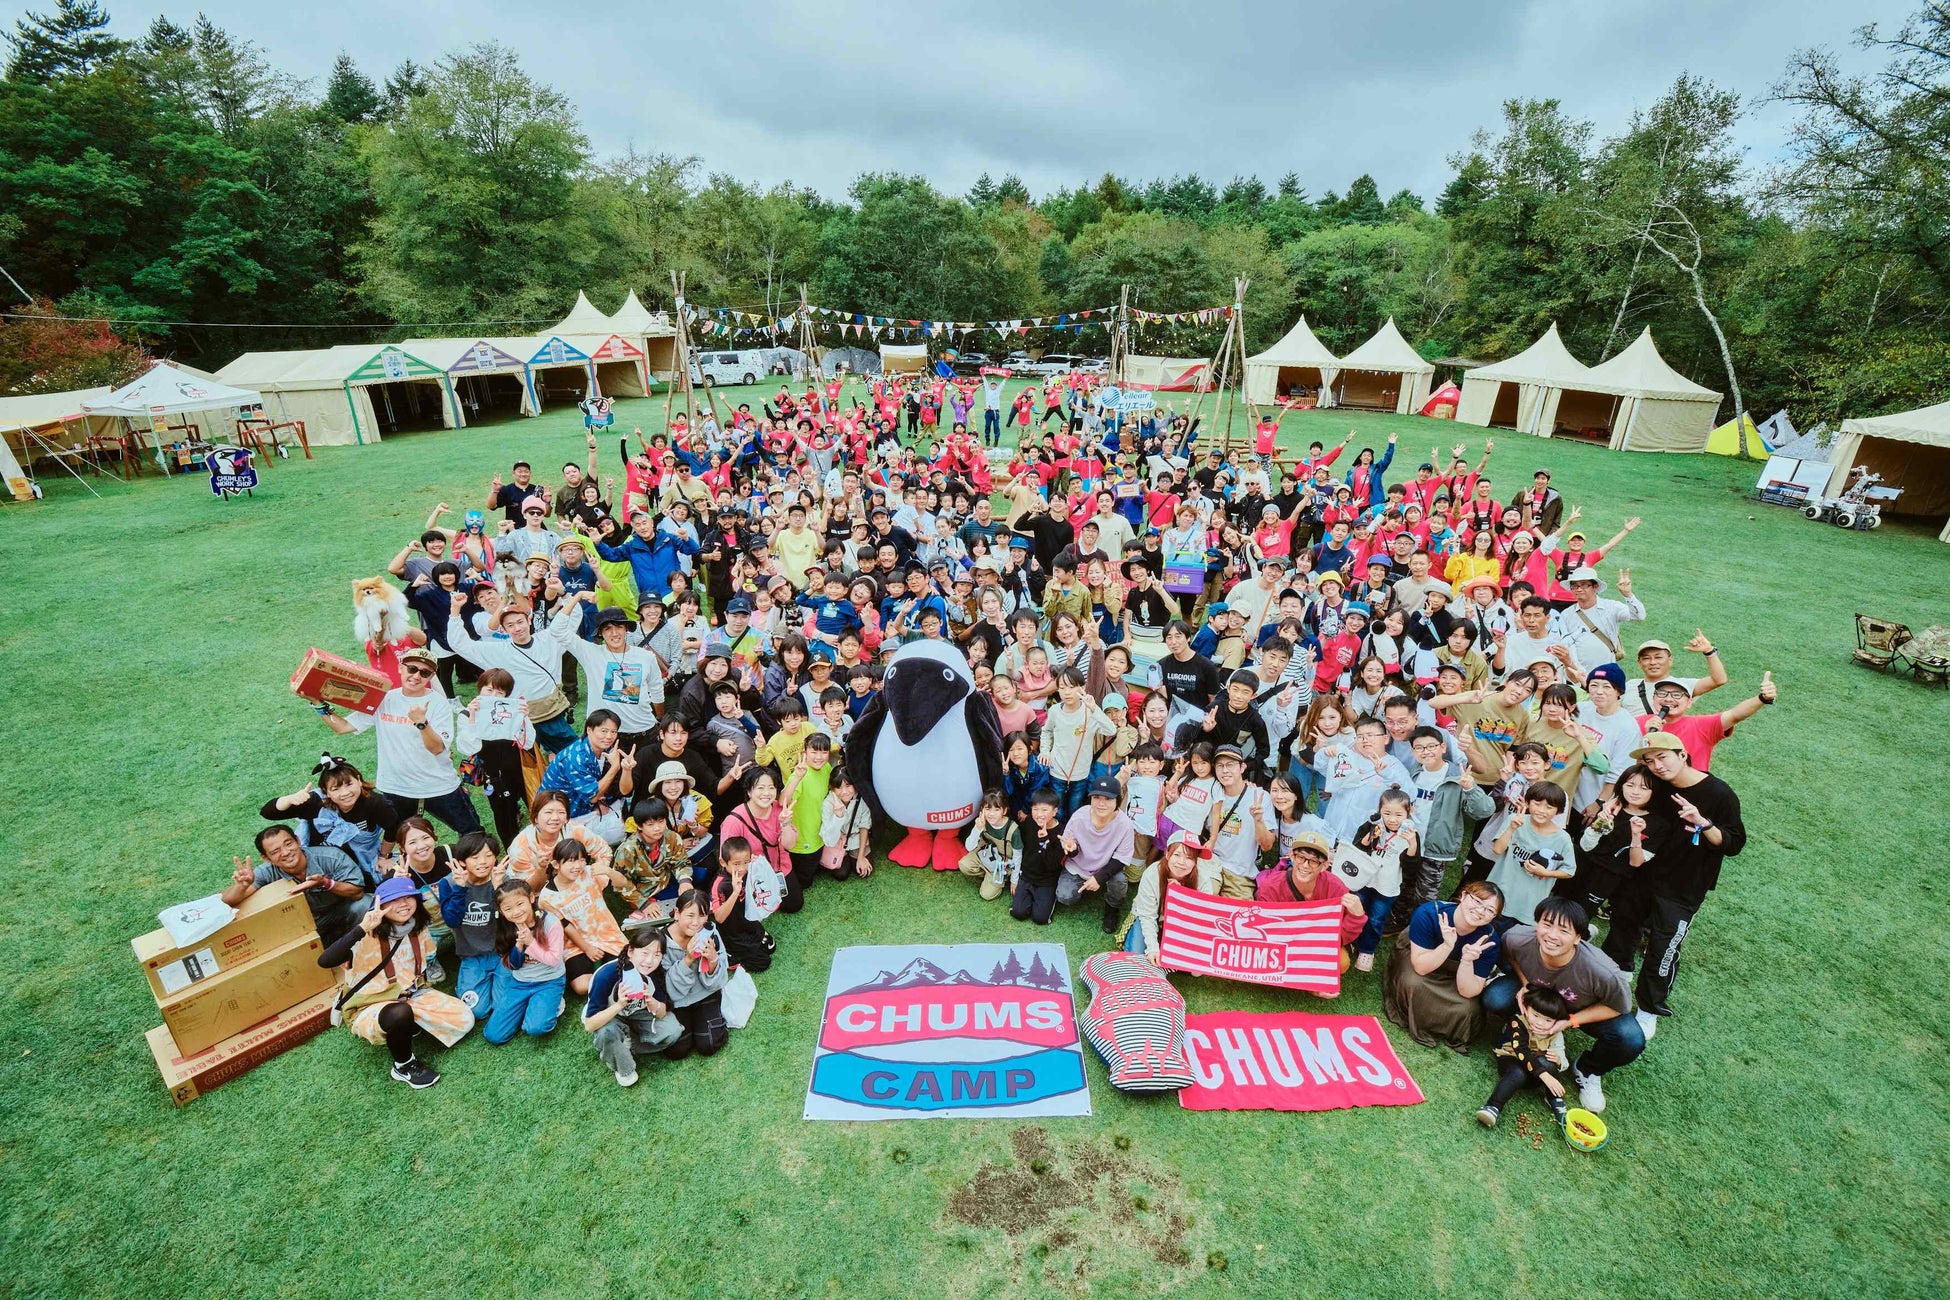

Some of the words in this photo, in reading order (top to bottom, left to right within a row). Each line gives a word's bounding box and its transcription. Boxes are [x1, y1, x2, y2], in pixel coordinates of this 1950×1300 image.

[1117, 401, 1155, 410] エリエール
[930, 806, 970, 822] CHUMS
[459, 912, 489, 920] CHUMS
[1217, 943, 1280, 969] CHUMS
[1100, 981, 1179, 1014] CHUMS
[836, 1001, 1063, 1033] CHUMS
[1185, 1027, 1392, 1089] CHUMS
[861, 1070, 1035, 1102] CAMP
